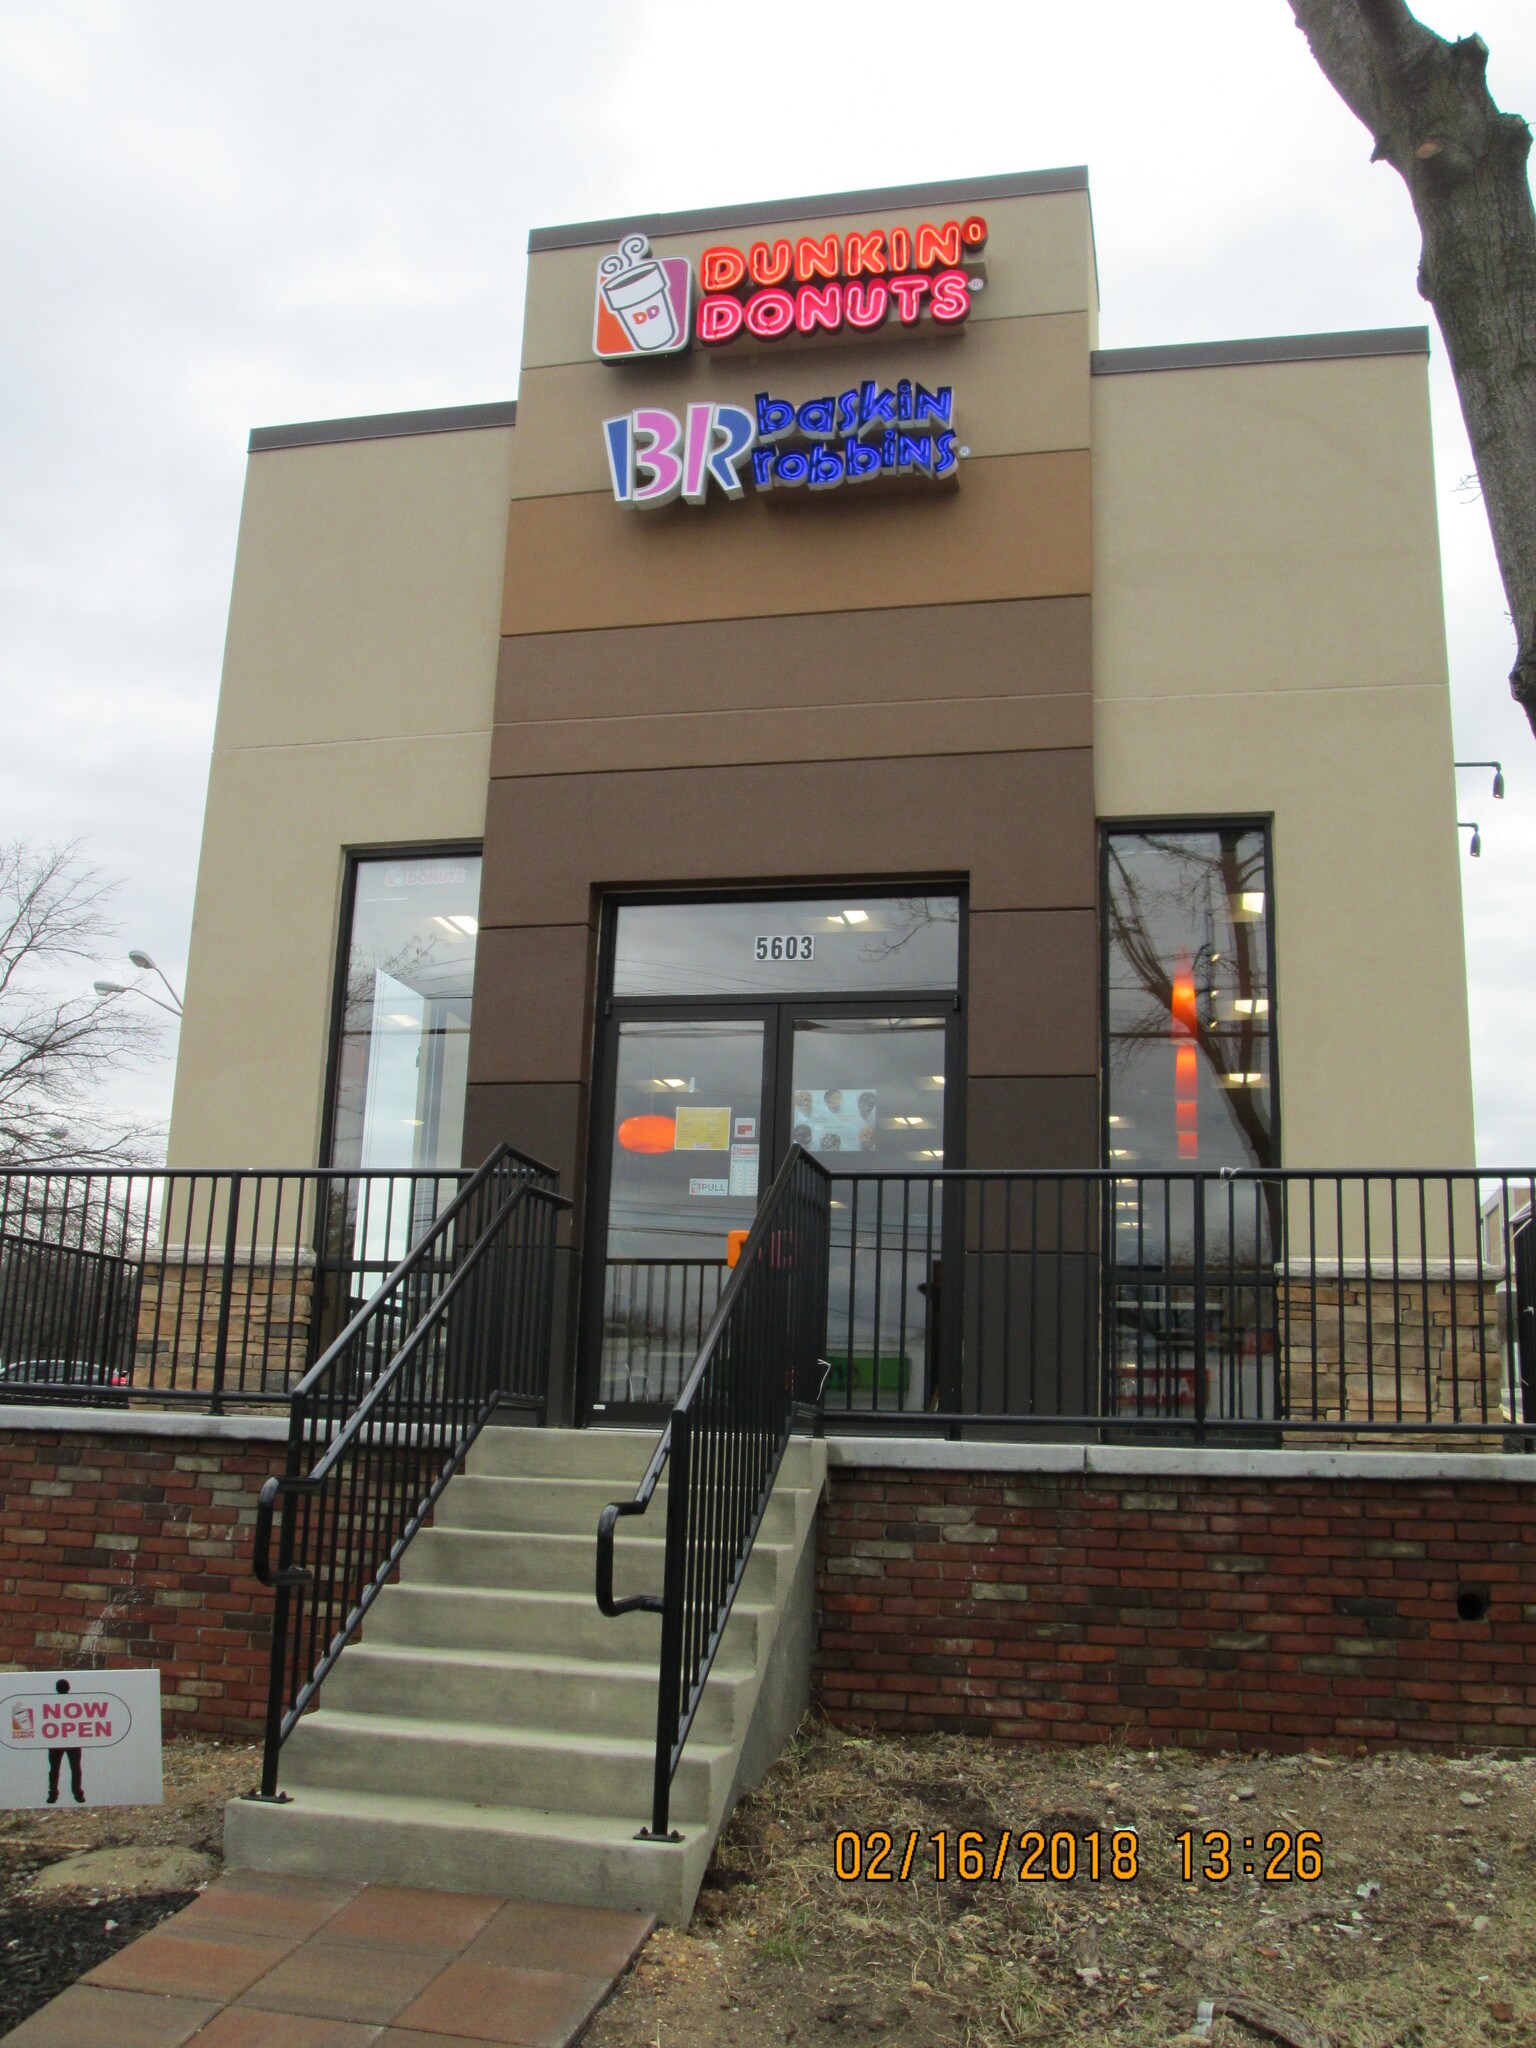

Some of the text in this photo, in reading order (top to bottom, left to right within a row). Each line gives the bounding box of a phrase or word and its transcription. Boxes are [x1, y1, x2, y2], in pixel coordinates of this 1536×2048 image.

[700, 216, 987, 293] DUNKIN'
[632, 305, 660, 325] DD
[697, 271, 970, 343] DONUTS
[756, 936, 813, 960] 5603
[701, 1183, 726, 1192] PULL
[43, 1702, 108, 1719] NOW
[42, 1721, 112, 1739] OPEN
